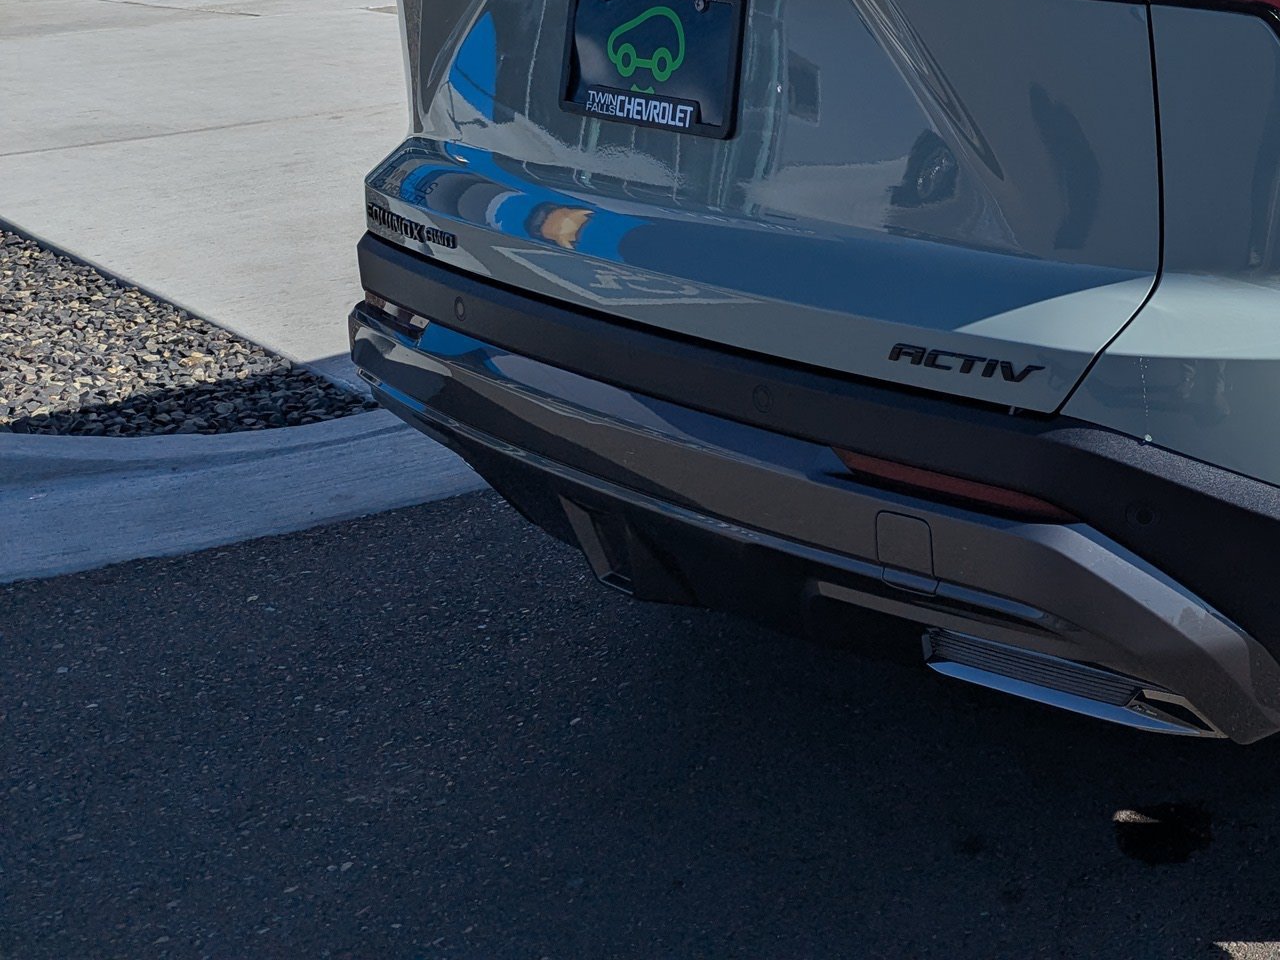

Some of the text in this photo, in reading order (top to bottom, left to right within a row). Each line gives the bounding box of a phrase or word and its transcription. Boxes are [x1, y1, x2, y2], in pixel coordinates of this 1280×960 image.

[586, 101, 616, 116] FALLS
[588, 91, 617, 106] TWIN
[615, 95, 694, 128] CHEVROLET
[368, 202, 425, 243] EQUINOX
[888, 343, 1046, 383] ACTIV
